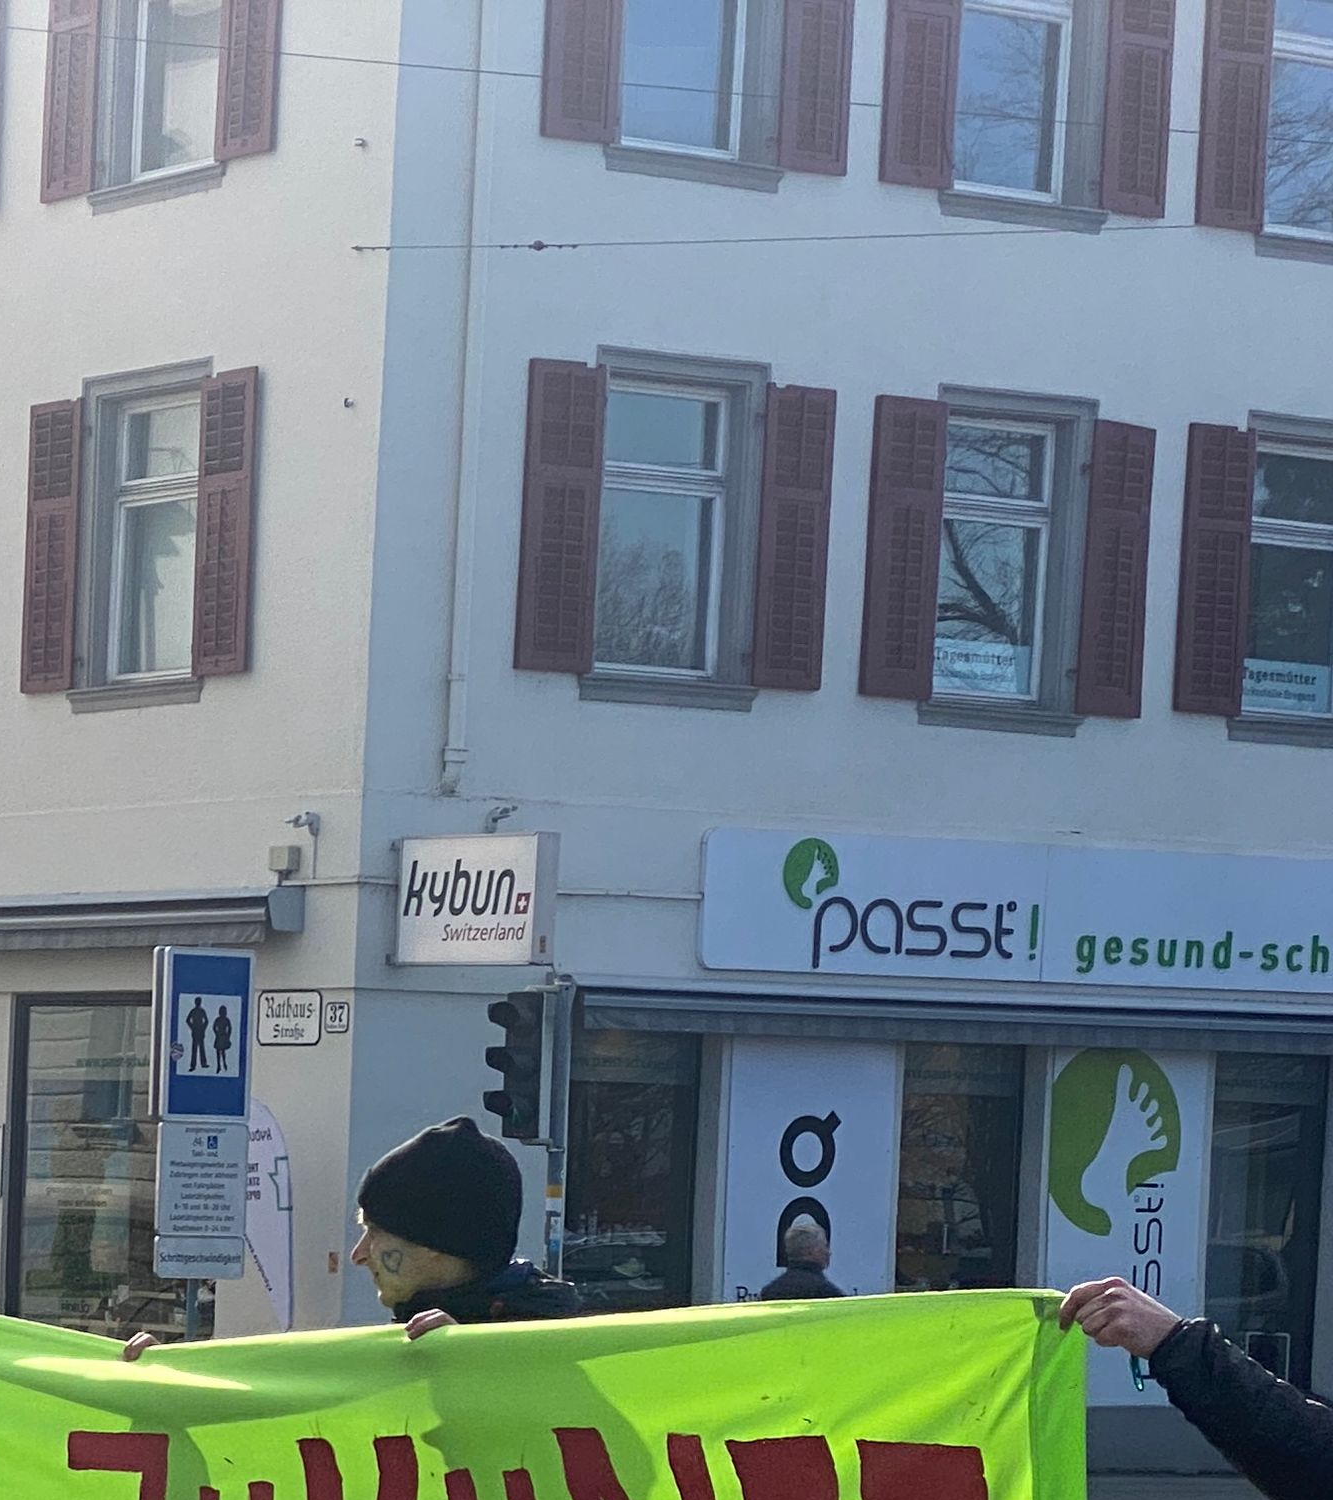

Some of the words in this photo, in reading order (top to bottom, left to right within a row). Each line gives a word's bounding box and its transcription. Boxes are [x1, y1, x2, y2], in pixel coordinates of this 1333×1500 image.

[402, 858, 517, 918] kybun
[441, 921, 527, 942] Switzerland
[1075, 930, 1332, 974] gesund-sch
[329, 1005, 345, 1023] 37
[159, 1251, 242, 1266] Schrittgeschwindigkeit
